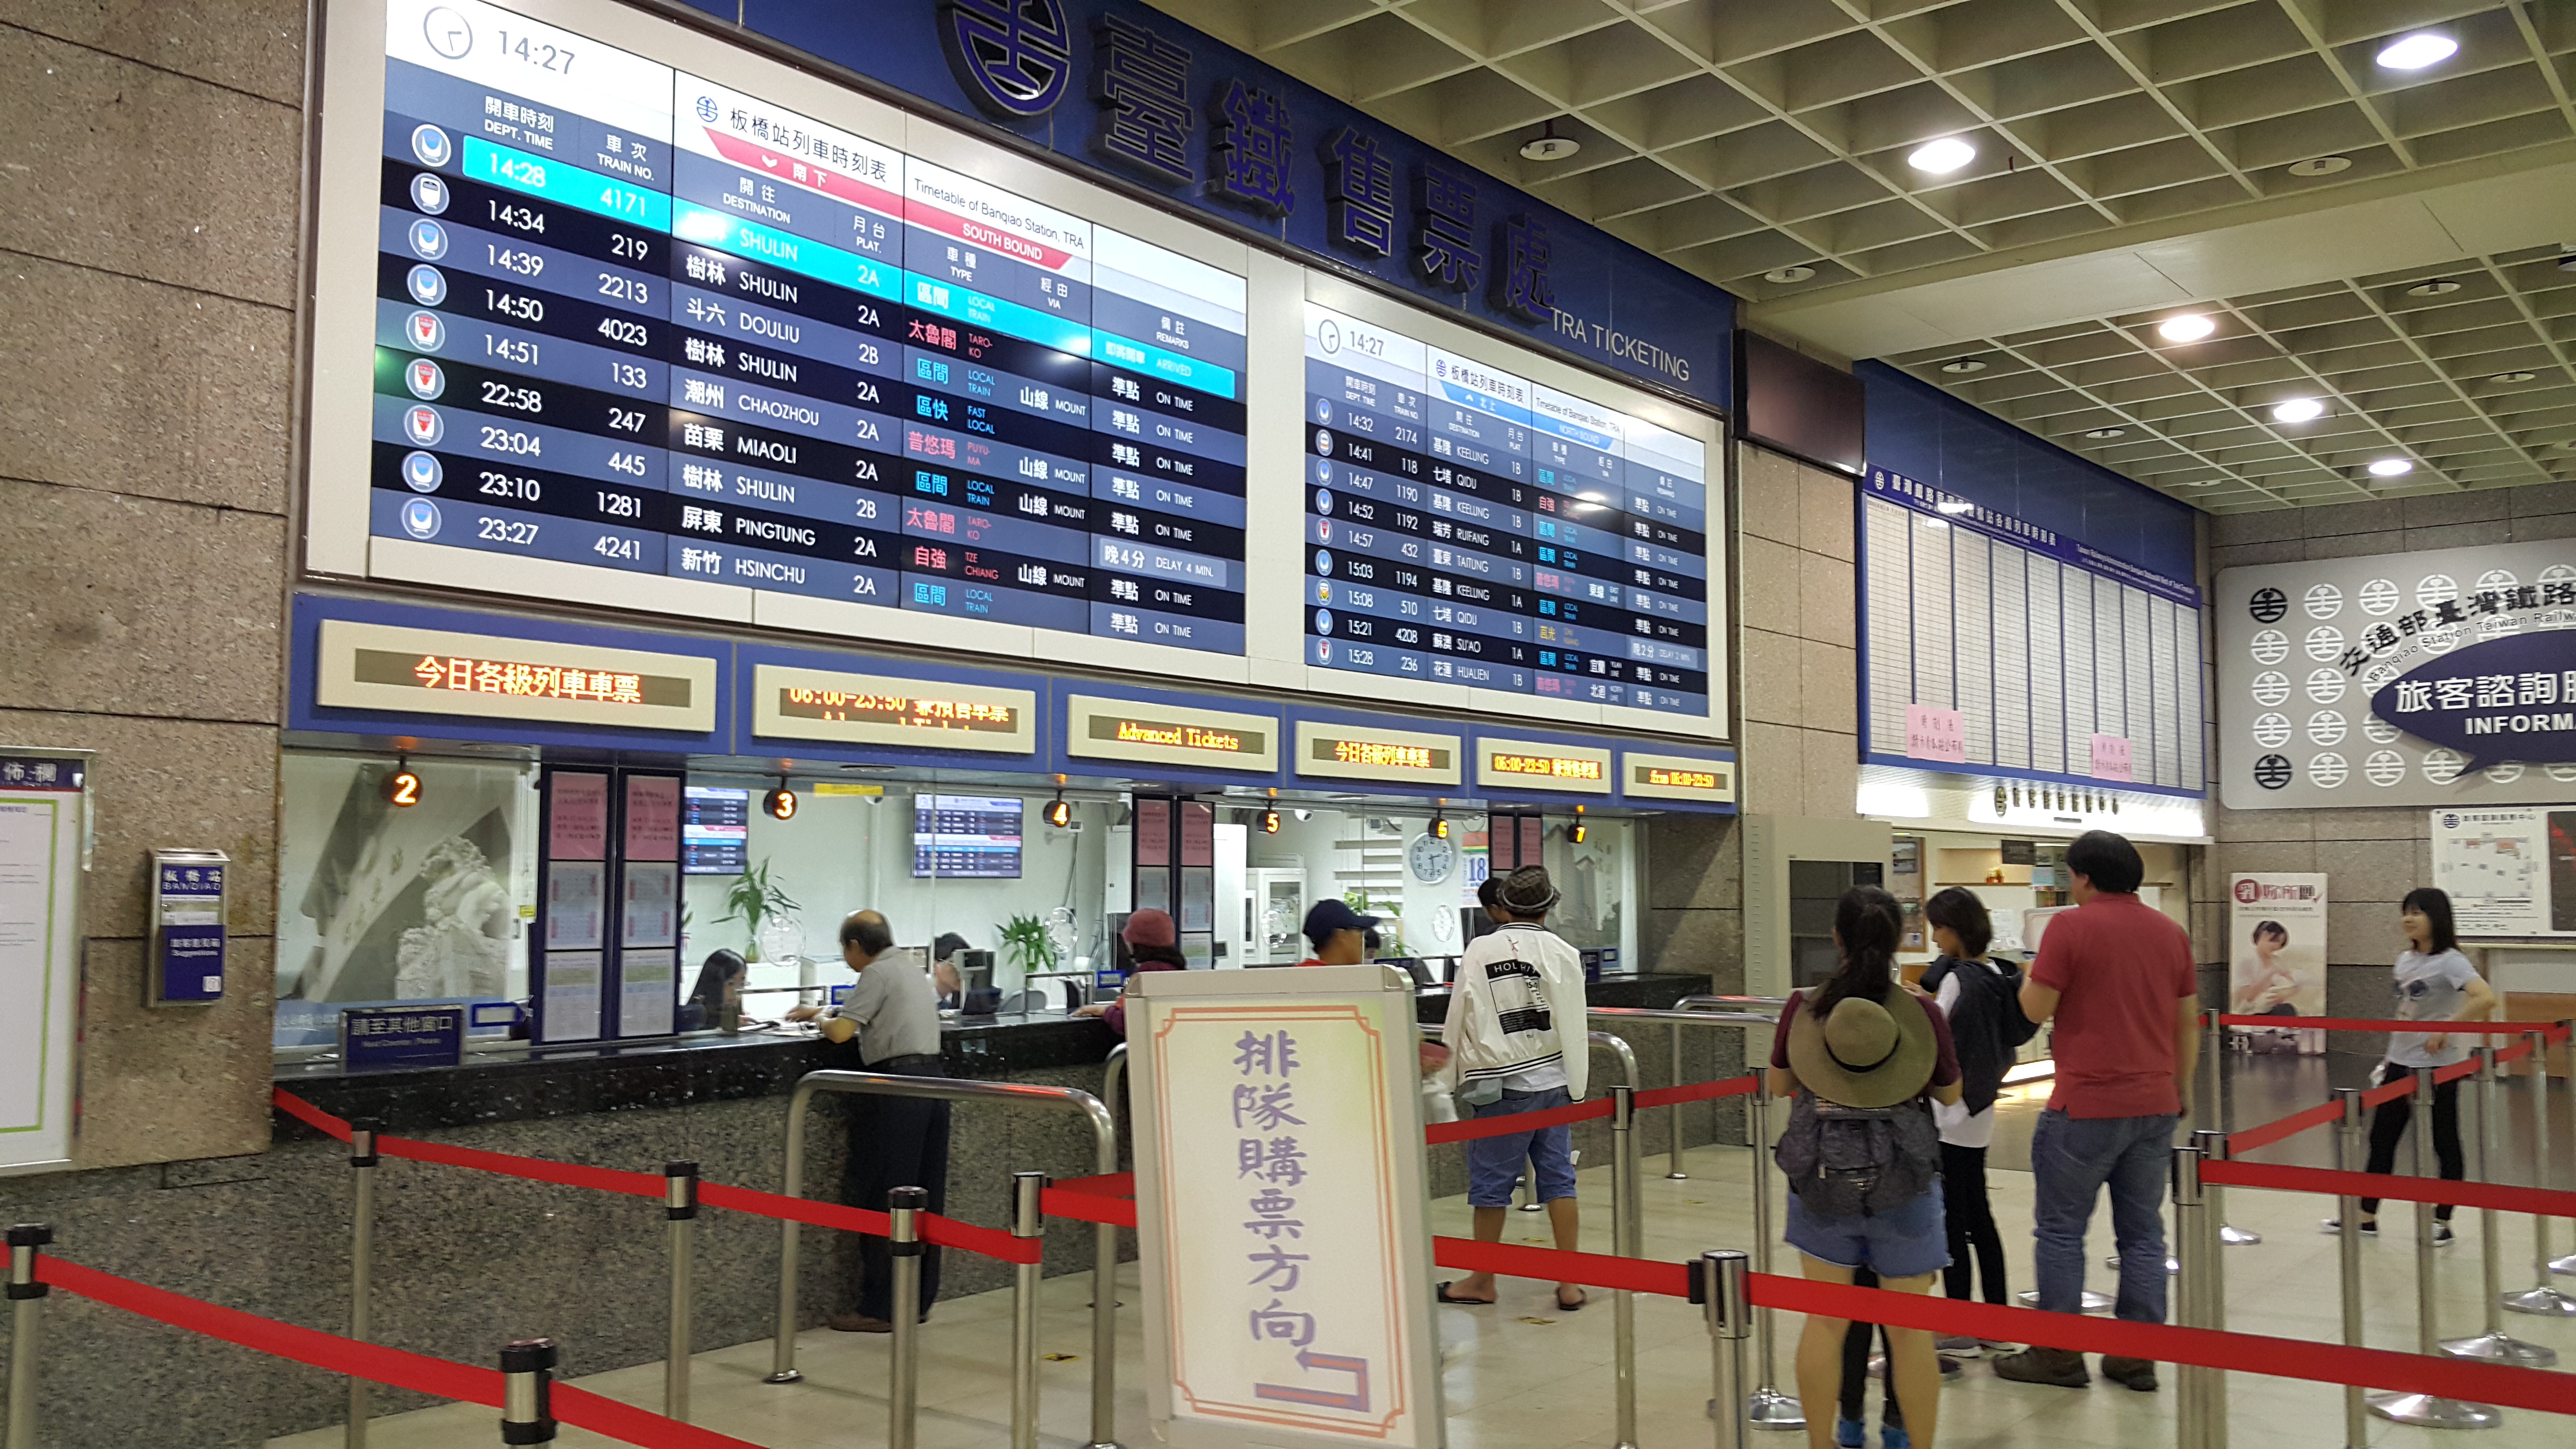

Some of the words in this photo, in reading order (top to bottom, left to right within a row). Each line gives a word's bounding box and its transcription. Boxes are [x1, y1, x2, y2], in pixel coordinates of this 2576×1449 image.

[499, 31, 575, 75] 14:27
[485, 96, 554, 133] 開車時刻
[484, 118, 521, 141] DEPT.
[523, 130, 553, 151] TIME
[730, 107, 886, 183] 板橋站列車時刻表
[606, 134, 646, 162] 車次
[490, 153, 546, 188] 14:28
[597, 152, 630, 174] TRAIN
[629, 163, 654, 181] NO.
[792, 162, 827, 188] 南下
[1105, 12, 1555, 322] 臺鐵售票處
[600, 188, 645, 217] 4171
[740, 177, 775, 204] 開往
[489, 200, 545, 234] 14:34
[723, 193, 790, 224] DESTINATION
[914, 177, 966, 208] Timetable
[969, 200, 979, 211] of
[982, 202, 1022, 227] Banqiao
[1025, 218, 1060, 242] Station,
[1063, 231, 1084, 249] TRA
[853, 215, 885, 240] 月台
[612, 234, 648, 260] 219
[740, 228, 798, 262] SHULIN
[856, 236, 882, 254] PLAT.
[963, 223, 1002, 247] SOUTH
[1003, 236, 1042, 260] BOUND
[488, 244, 544, 277] 14:39
[947, 246, 976, 269] 車種
[686, 255, 726, 286] 樹林
[858, 264, 880, 288] 2A
[950, 265, 973, 282] TYPE
[598, 273, 648, 304] 2213
[739, 272, 798, 304] SHULIN
[917, 281, 950, 310] 區間
[1041, 277, 1067, 298] 經由
[486, 289, 544, 322] 14:50
[686, 298, 725, 326] 斗六
[1047, 297, 1061, 310] VIA
[740, 312, 799, 343] DOULIU
[858, 305, 880, 328] 2A
[597, 318, 647, 347] 4023
[908, 319, 956, 351] 太魯閣
[1156, 331, 1189, 350] REMARKS
[1350, 331, 1384, 356] 14:27
[1551, 307, 1588, 344] TRA
[1593, 324, 1690, 381] TICKETING
[485, 334, 538, 366] 14:51
[684, 337, 726, 368] 樹林
[859, 343, 879, 365] 2B
[612, 362, 647, 388] 133
[738, 352, 797, 383] SHULIN
[917, 357, 950, 385] 區間
[684, 379, 724, 409] 潮州
[857, 381, 880, 403] 2A
[1451, 365, 1523, 403] 板橋站列車時刻表
[482, 381, 542, 413] 22:58
[917, 394, 949, 421] 區快
[1020, 386, 1048, 410] 山線
[1055, 399, 1086, 416] MOUNT
[1156, 391, 1171, 405] ON
[1174, 396, 1193, 412] TIME
[609, 407, 646, 433] 247
[738, 394, 819, 426] CHAOZHOU
[1348, 412, 1373, 432] 14:32
[480, 426, 541, 457] 23:04
[683, 423, 724, 452] 苗栗
[857, 419, 879, 441] 2A
[1395, 426, 1417, 444] 2174
[737, 436, 797, 464] MIAOLI
[908, 431, 955, 460] 普悠瑪
[1349, 443, 1372, 462] 14:41
[1457, 446, 1489, 465] KEELUNG
[608, 452, 645, 476] 445
[856, 460, 878, 482] 2A
[1019, 456, 1048, 480] 山線
[1055, 468, 1085, 484] MOUNT
[1401, 457, 1418, 474] 118
[479, 471, 541, 501] 23:10
[682, 464, 723, 493] 樹林
[736, 476, 794, 503] SHULIN
[915, 470, 948, 497] 區間
[1349, 472, 1373, 490] 14:47
[1456, 473, 1477, 490] QIDU
[597, 491, 641, 518] 1281
[1019, 493, 1048, 516] 山線
[1397, 484, 1418, 502] 1190
[681, 505, 723, 533] 屏東
[856, 499, 876, 519] 2B
[906, 507, 955, 534] 太魯閣
[1054, 504, 1085, 519] MOUNT
[1349, 501, 1373, 520] 14:52
[1397, 513, 1418, 530] 1192
[1457, 501, 1489, 519] KEELUNG
[478, 516, 539, 545] 23:27
[736, 517, 816, 546] PINGTUNG
[1349, 530, 1373, 547] 14:57
[1456, 528, 1489, 546] RUIFANG
[594, 536, 640, 560] 4241
[854, 536, 877, 557] 2A
[915, 546, 947, 570] 自強
[1104, 545, 1145, 569] 晚4分
[1401, 543, 1418, 558] 432
[681, 547, 722, 575] 新竹
[735, 558, 805, 584] HSINCHU
[1156, 556, 1183, 571] DELAY
[1186, 563, 1191, 573] 4
[1195, 564, 1214, 577] MIN.
[1348, 561, 1373, 579] 15:03
[1456, 555, 1489, 573] TAITUNG
[853, 575, 876, 596] 2A
[1018, 564, 1047, 586] 山線
[1053, 574, 1085, 588] MOUNT
[1396, 570, 1417, 587] 1194
[914, 582, 947, 607] 區間
[1348, 590, 1373, 608] 15:08
[1456, 584, 1490, 601] KEELUNG
[1401, 600, 1417, 615] 510
[1457, 611, 1477, 626] QIDU
[1348, 619, 1371, 636] 15:21
[1395, 628, 1418, 644] 4208
[1348, 649, 1373, 665] 15:28
[2369, 644, 2419, 681] Banqiao
[2421, 624, 2472, 647] Station
[2475, 615, 2528, 631] Taiwan
[1401, 656, 1418, 672] 236
[1457, 666, 1489, 680] HUALIEN
[415, 656, 641, 703] 今日各級列車車票
[1118, 722, 1182, 745] Advanced
[1186, 727, 1239, 750] Tickets
[2465, 713, 2576, 735] INFORM
[394, 773, 416, 804] 2
[776, 792, 794, 817] 3
[1052, 804, 1068, 825] 4
[1266, 812, 1279, 833] 5
[1469, 857, 1487, 882] 18
[1233, 1030, 1316, 1347] 排隊購票方向
